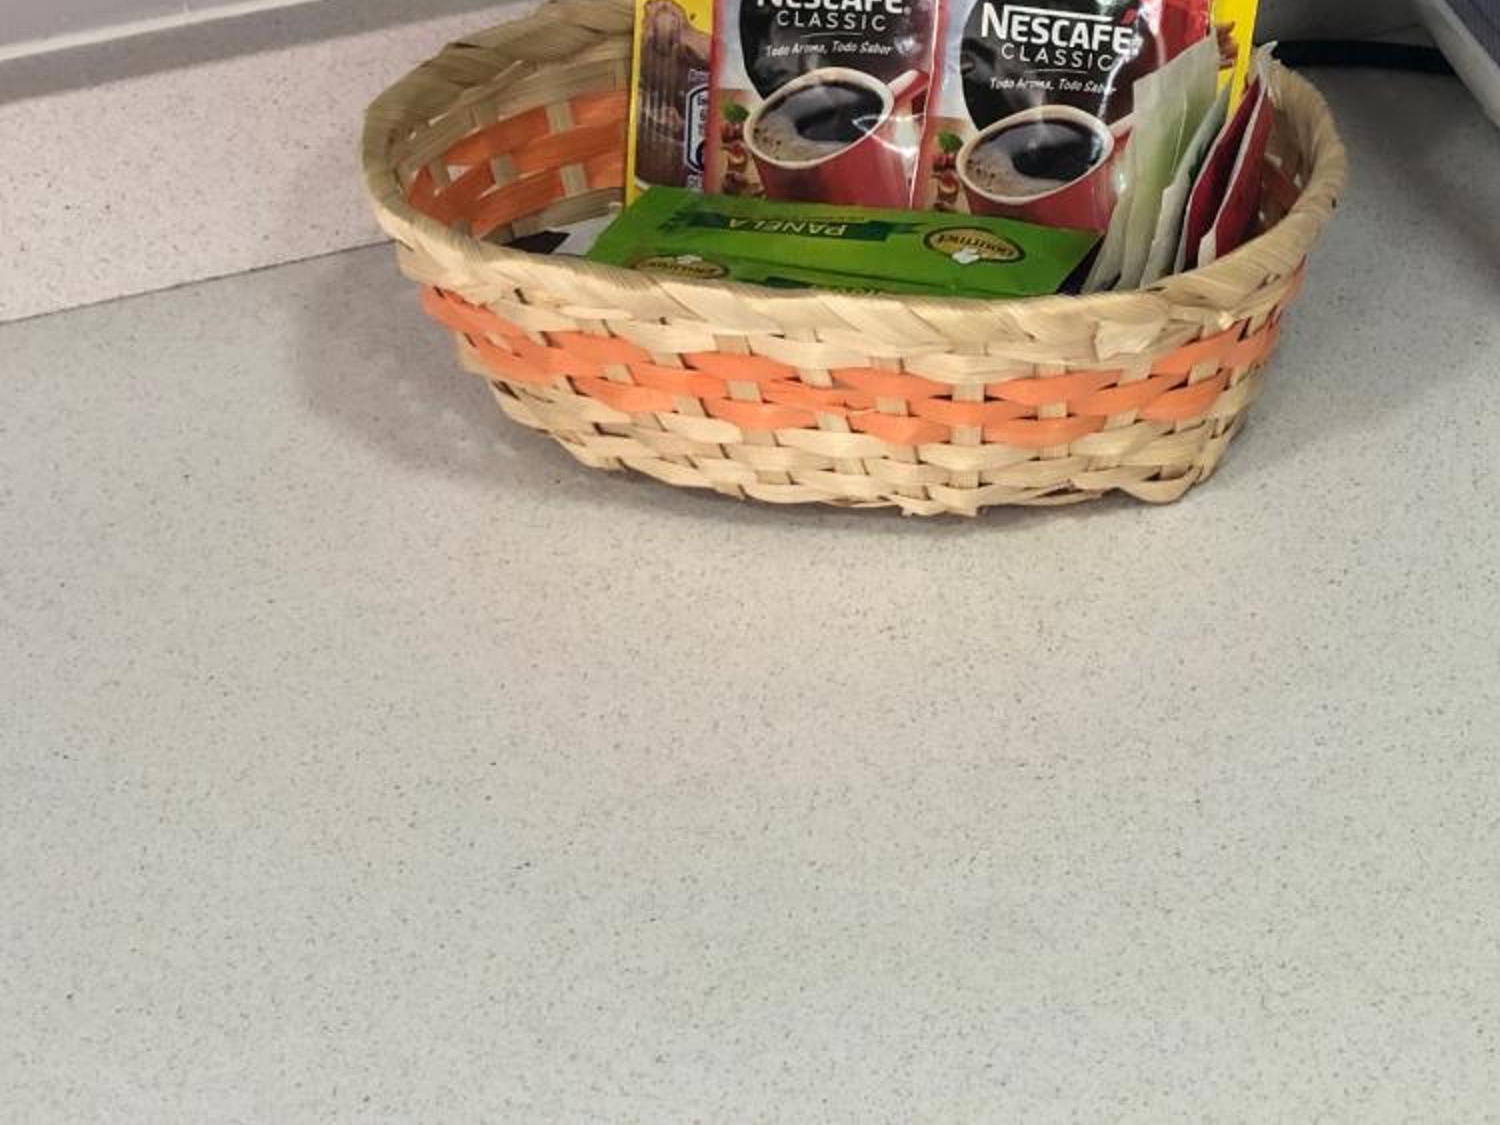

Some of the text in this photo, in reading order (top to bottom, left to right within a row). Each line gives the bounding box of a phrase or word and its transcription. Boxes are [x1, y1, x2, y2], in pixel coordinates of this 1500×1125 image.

[776, 10, 887, 32] CLASSIC
[1001, 42, 1114, 72] CLASSIC
[729, 218, 849, 237] PANELA
